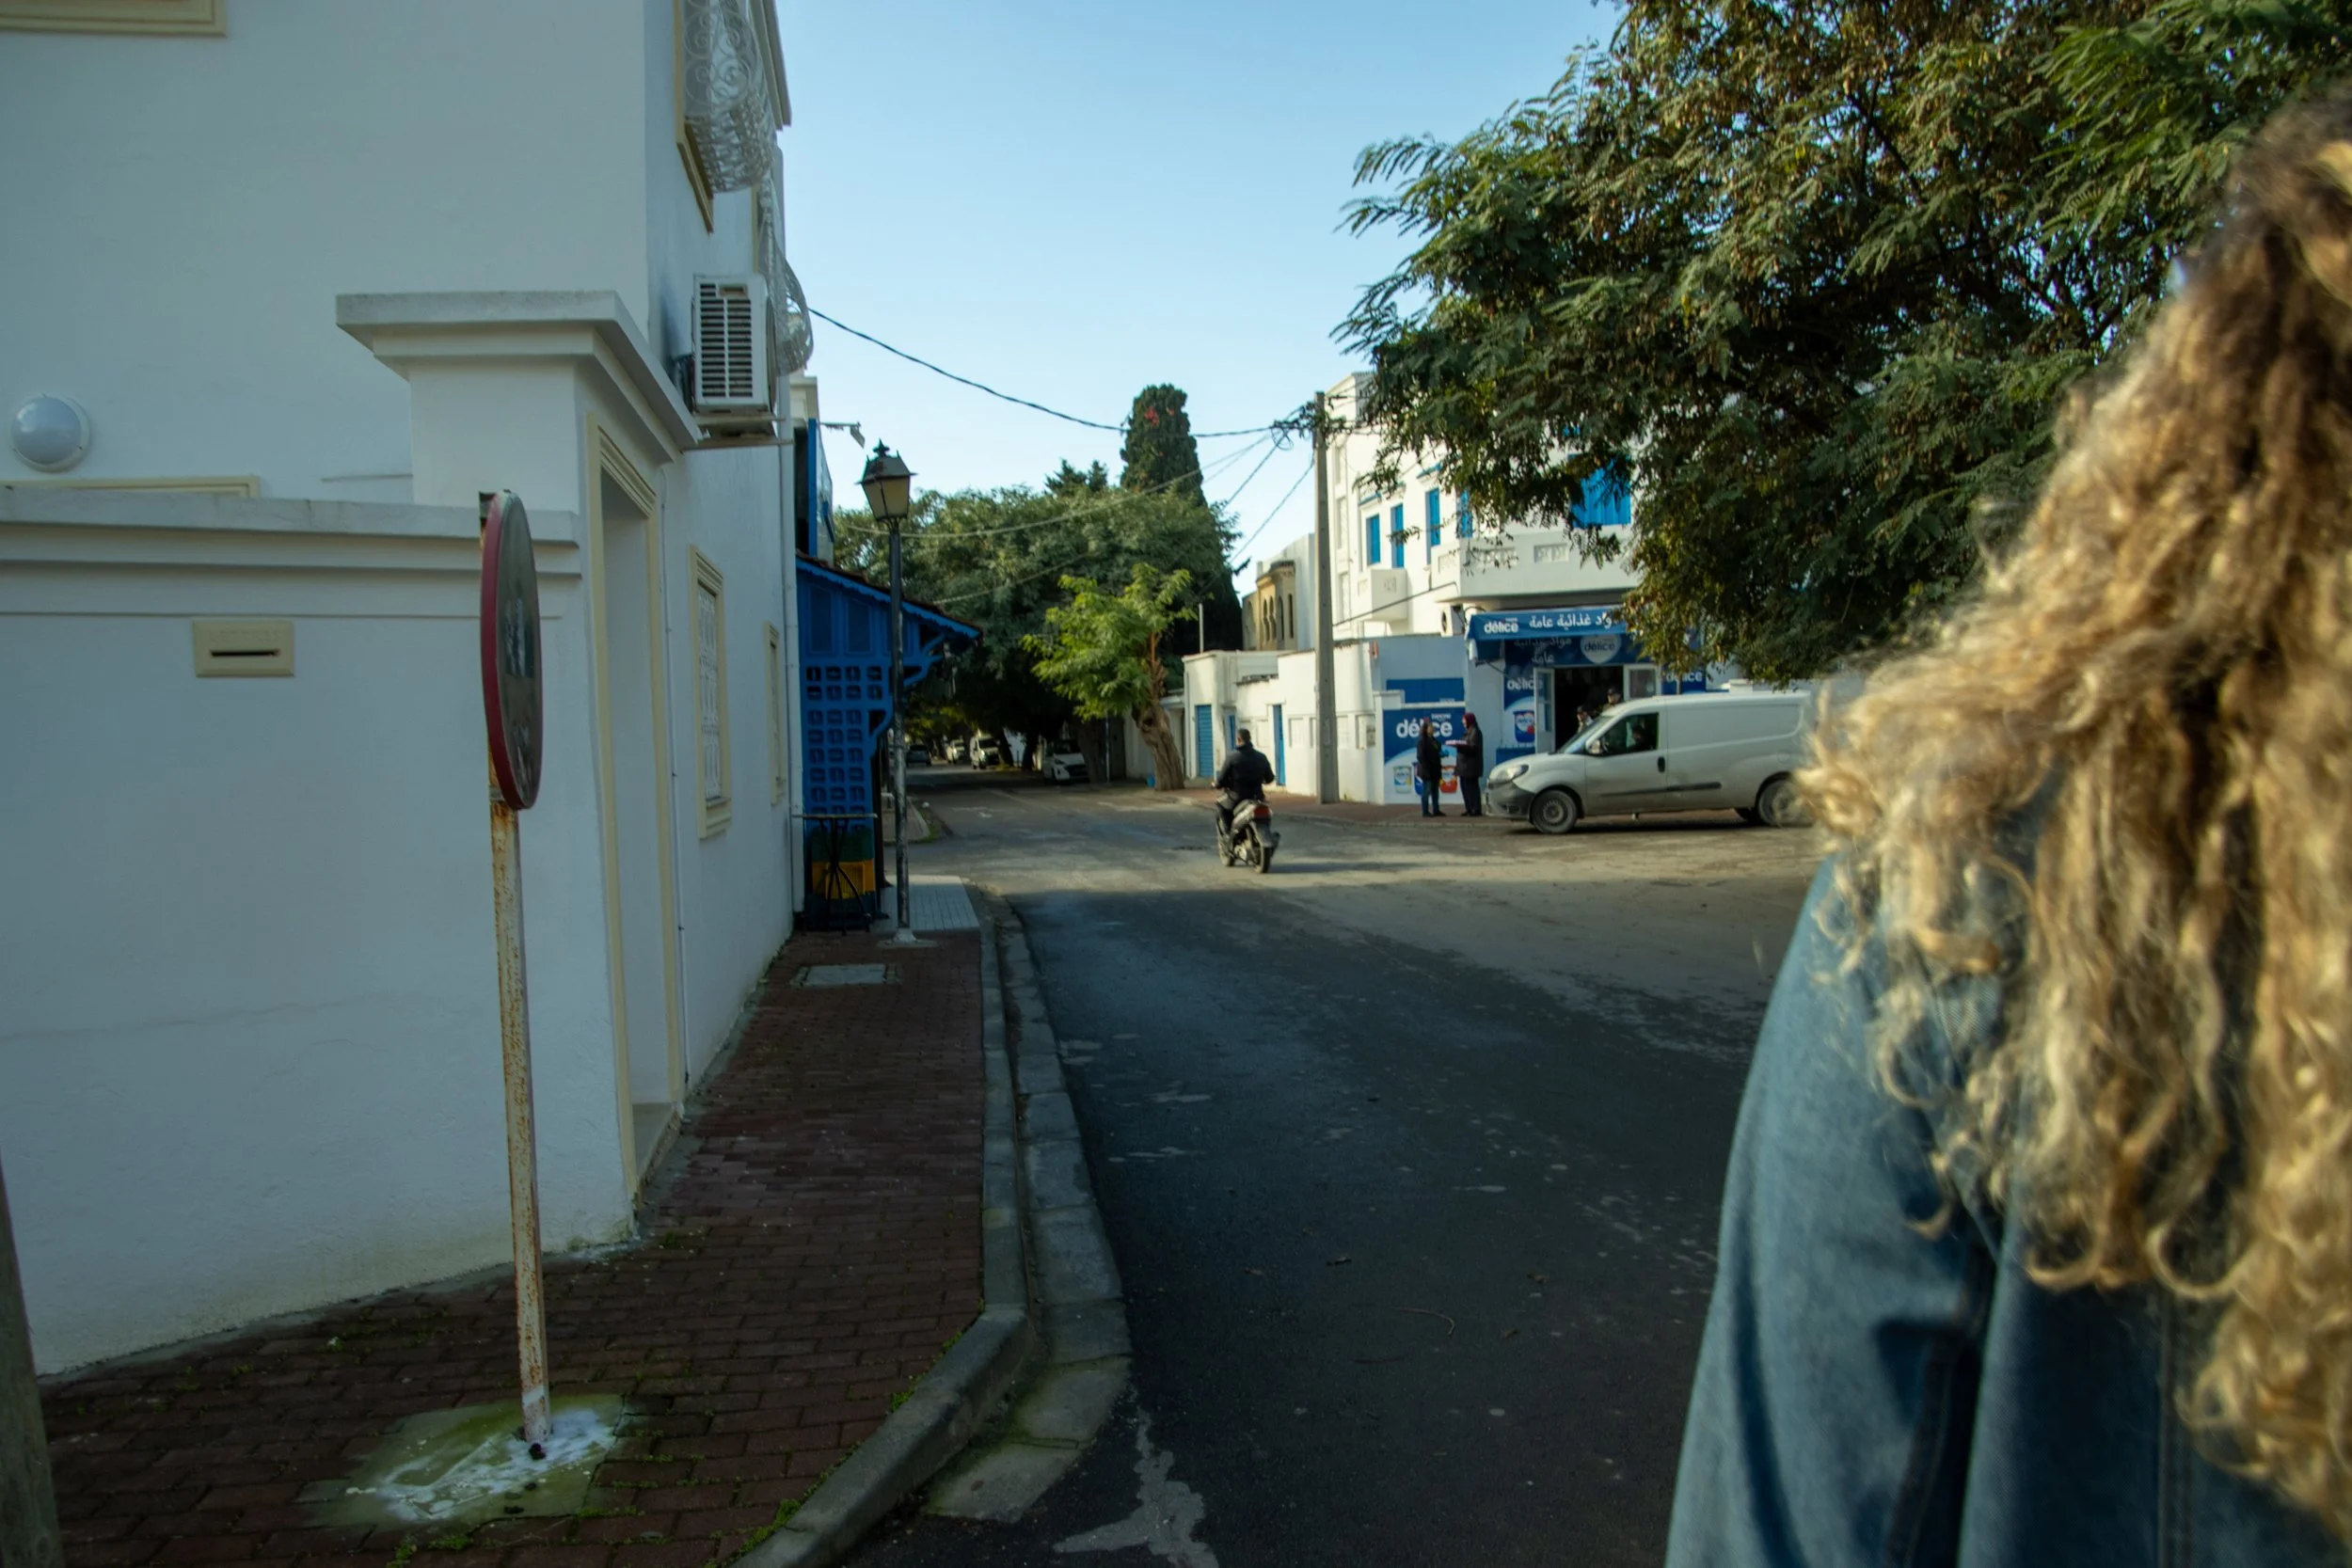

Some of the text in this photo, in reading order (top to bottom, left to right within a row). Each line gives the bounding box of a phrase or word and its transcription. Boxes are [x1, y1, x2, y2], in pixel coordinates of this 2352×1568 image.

[1484, 620, 1519, 634] délice
[1530, 615, 1553, 628] عامة
[1557, 612, 1592, 630] غذائية
[1584, 640, 1616, 652] délice
[1396, 718, 1453, 738] délce
